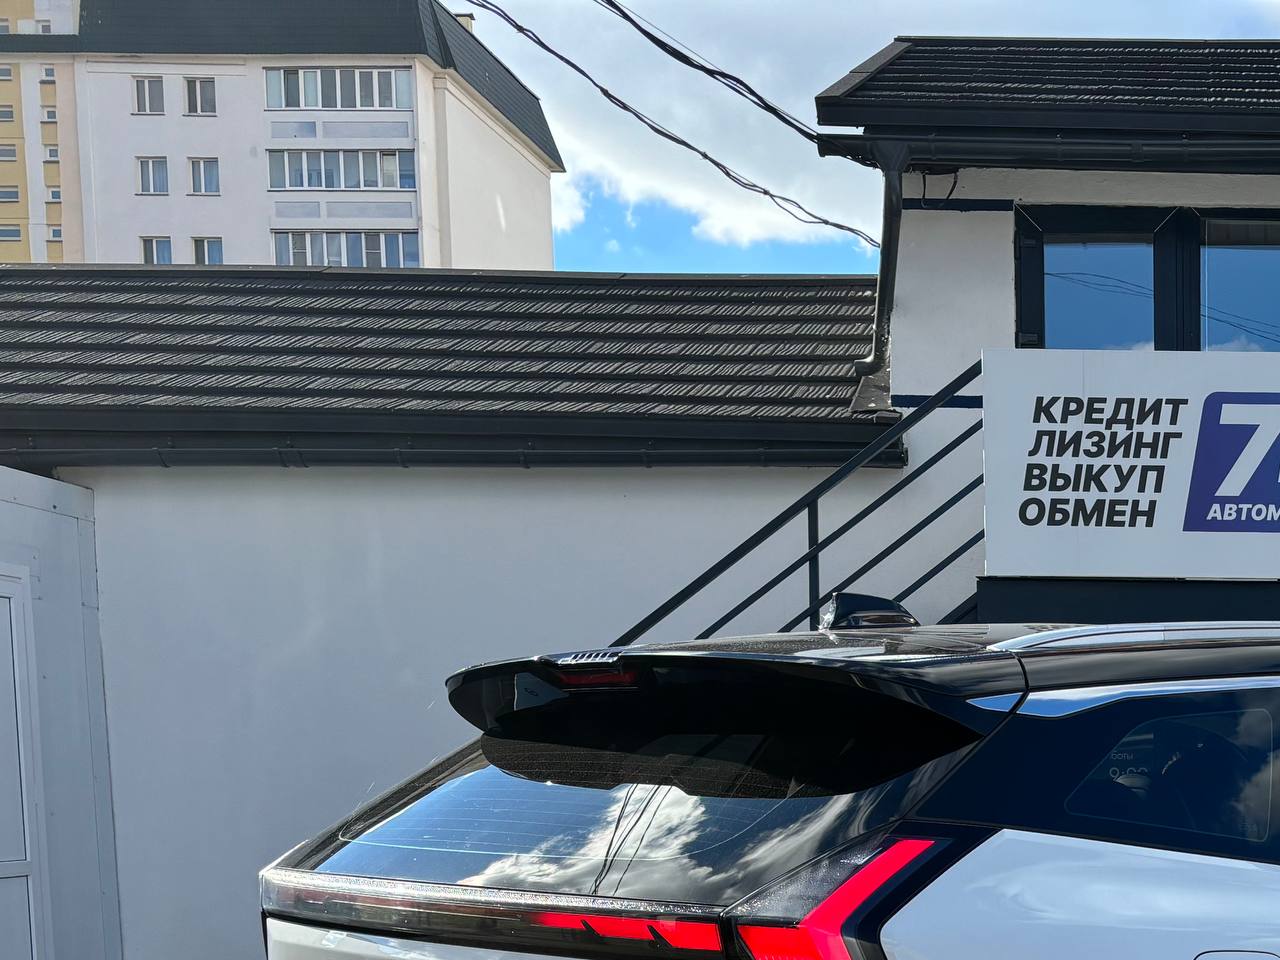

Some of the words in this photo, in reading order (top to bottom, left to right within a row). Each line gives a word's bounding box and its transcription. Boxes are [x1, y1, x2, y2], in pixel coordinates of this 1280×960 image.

[1032, 396, 1189, 430] КРЕДИТ
[1028, 430, 1183, 459] ЛИЗИНГ
[1023, 463, 1166, 493] ВЫКУП
[1018, 497, 1157, 528] ОБМЕН
